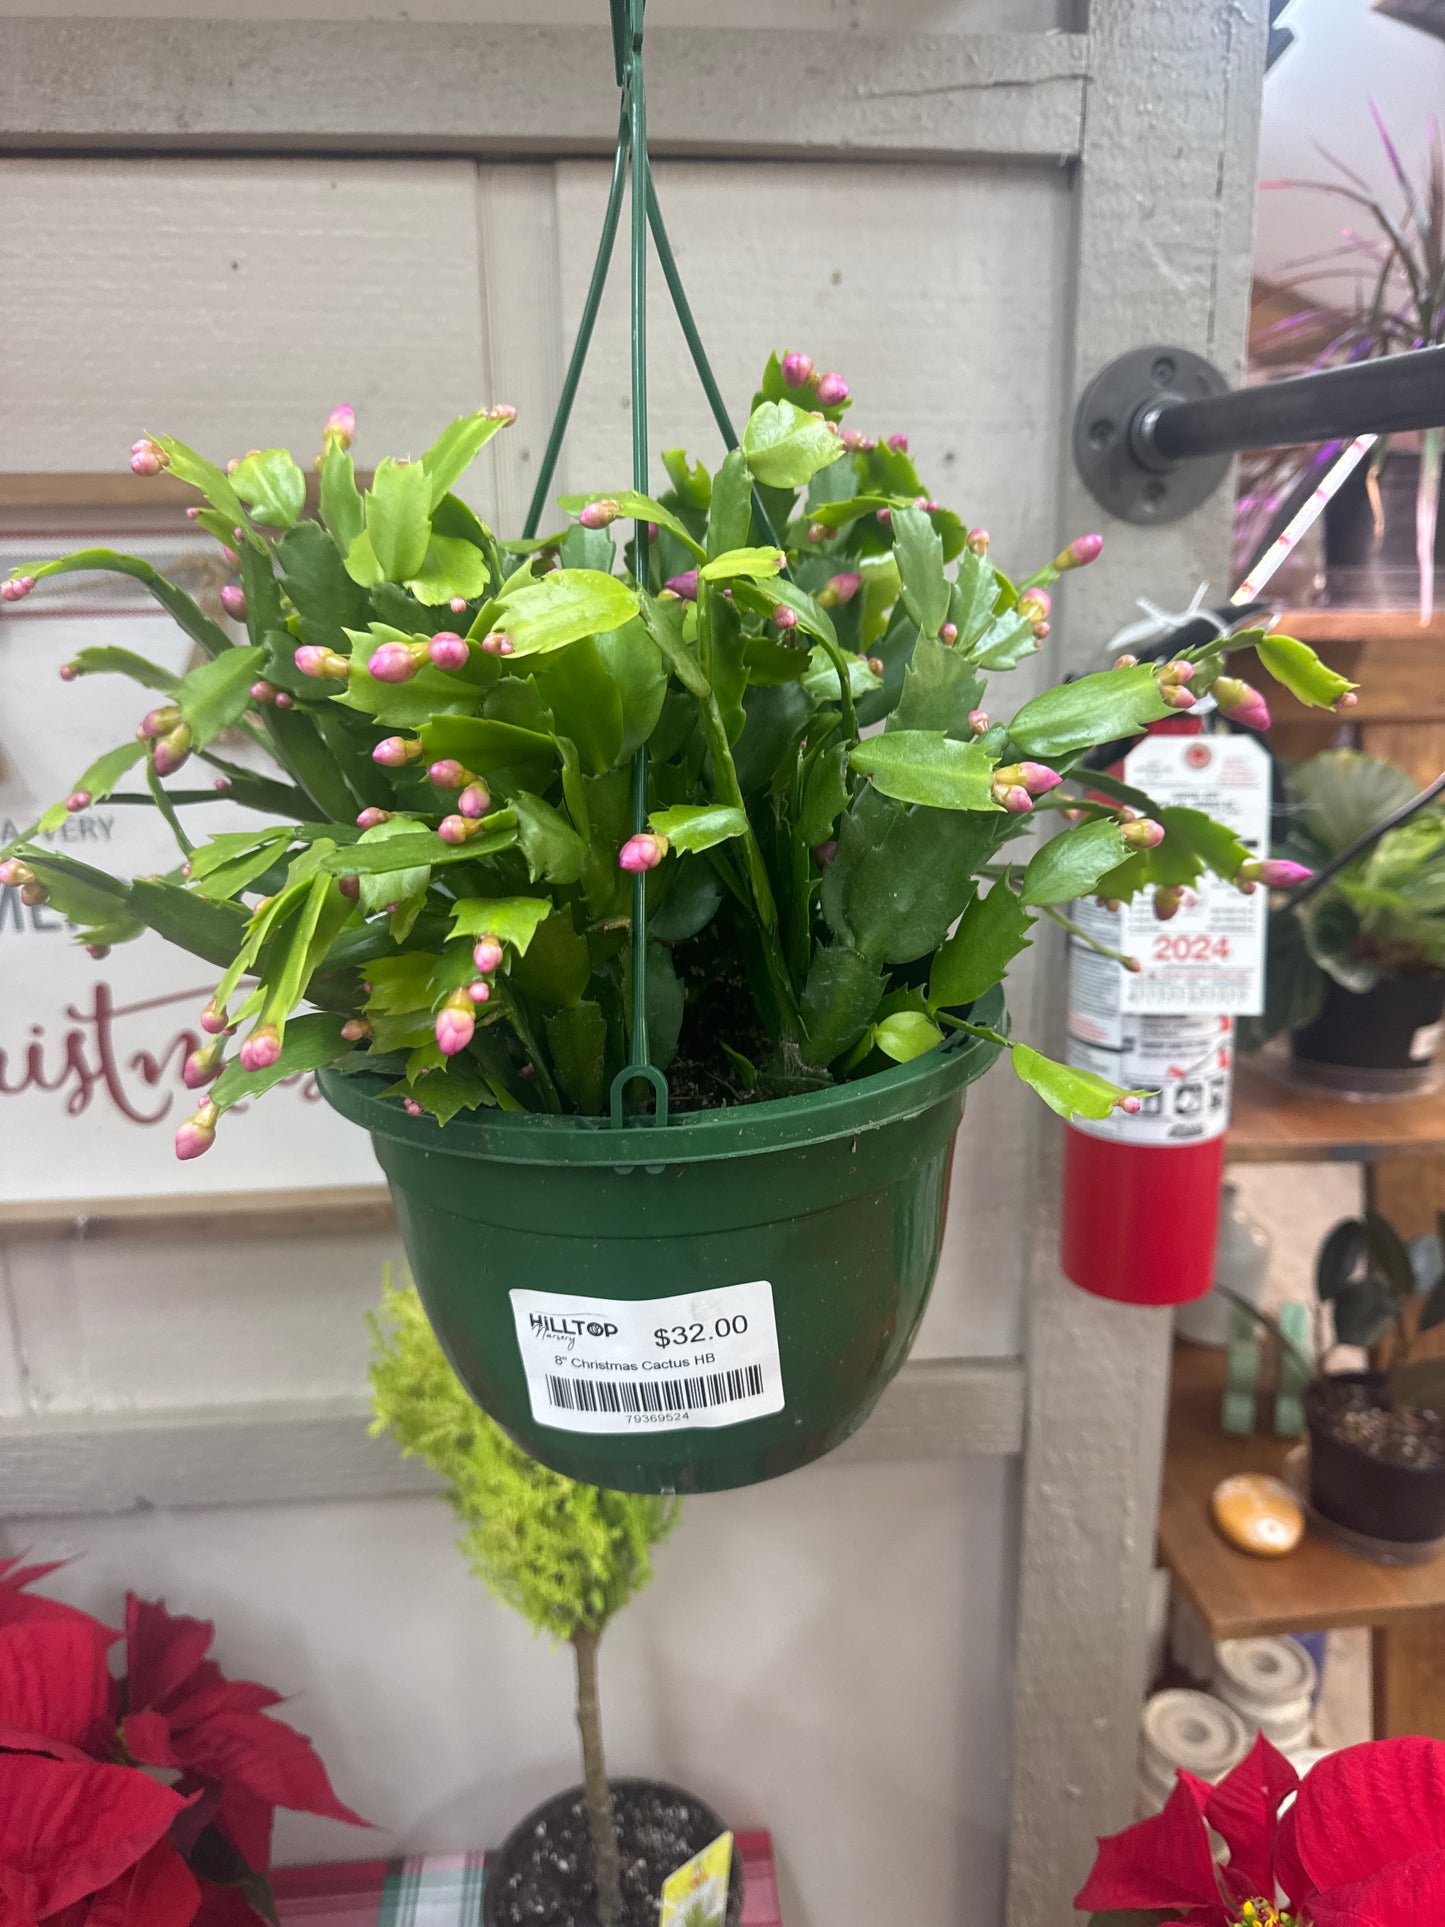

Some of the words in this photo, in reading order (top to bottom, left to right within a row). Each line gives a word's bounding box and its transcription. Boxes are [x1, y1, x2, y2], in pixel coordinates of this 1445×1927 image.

[1154, 935, 1229, 960] 2024
[654, 1315, 748, 1349] $32.00
[554, 1355, 568, 1366] 8"
[571, 1358, 638, 1371] Christmas
[642, 1359, 690, 1371] Cactus
[695, 1353, 716, 1365] HB
[625, 1412, 690, 1424] 79369524
